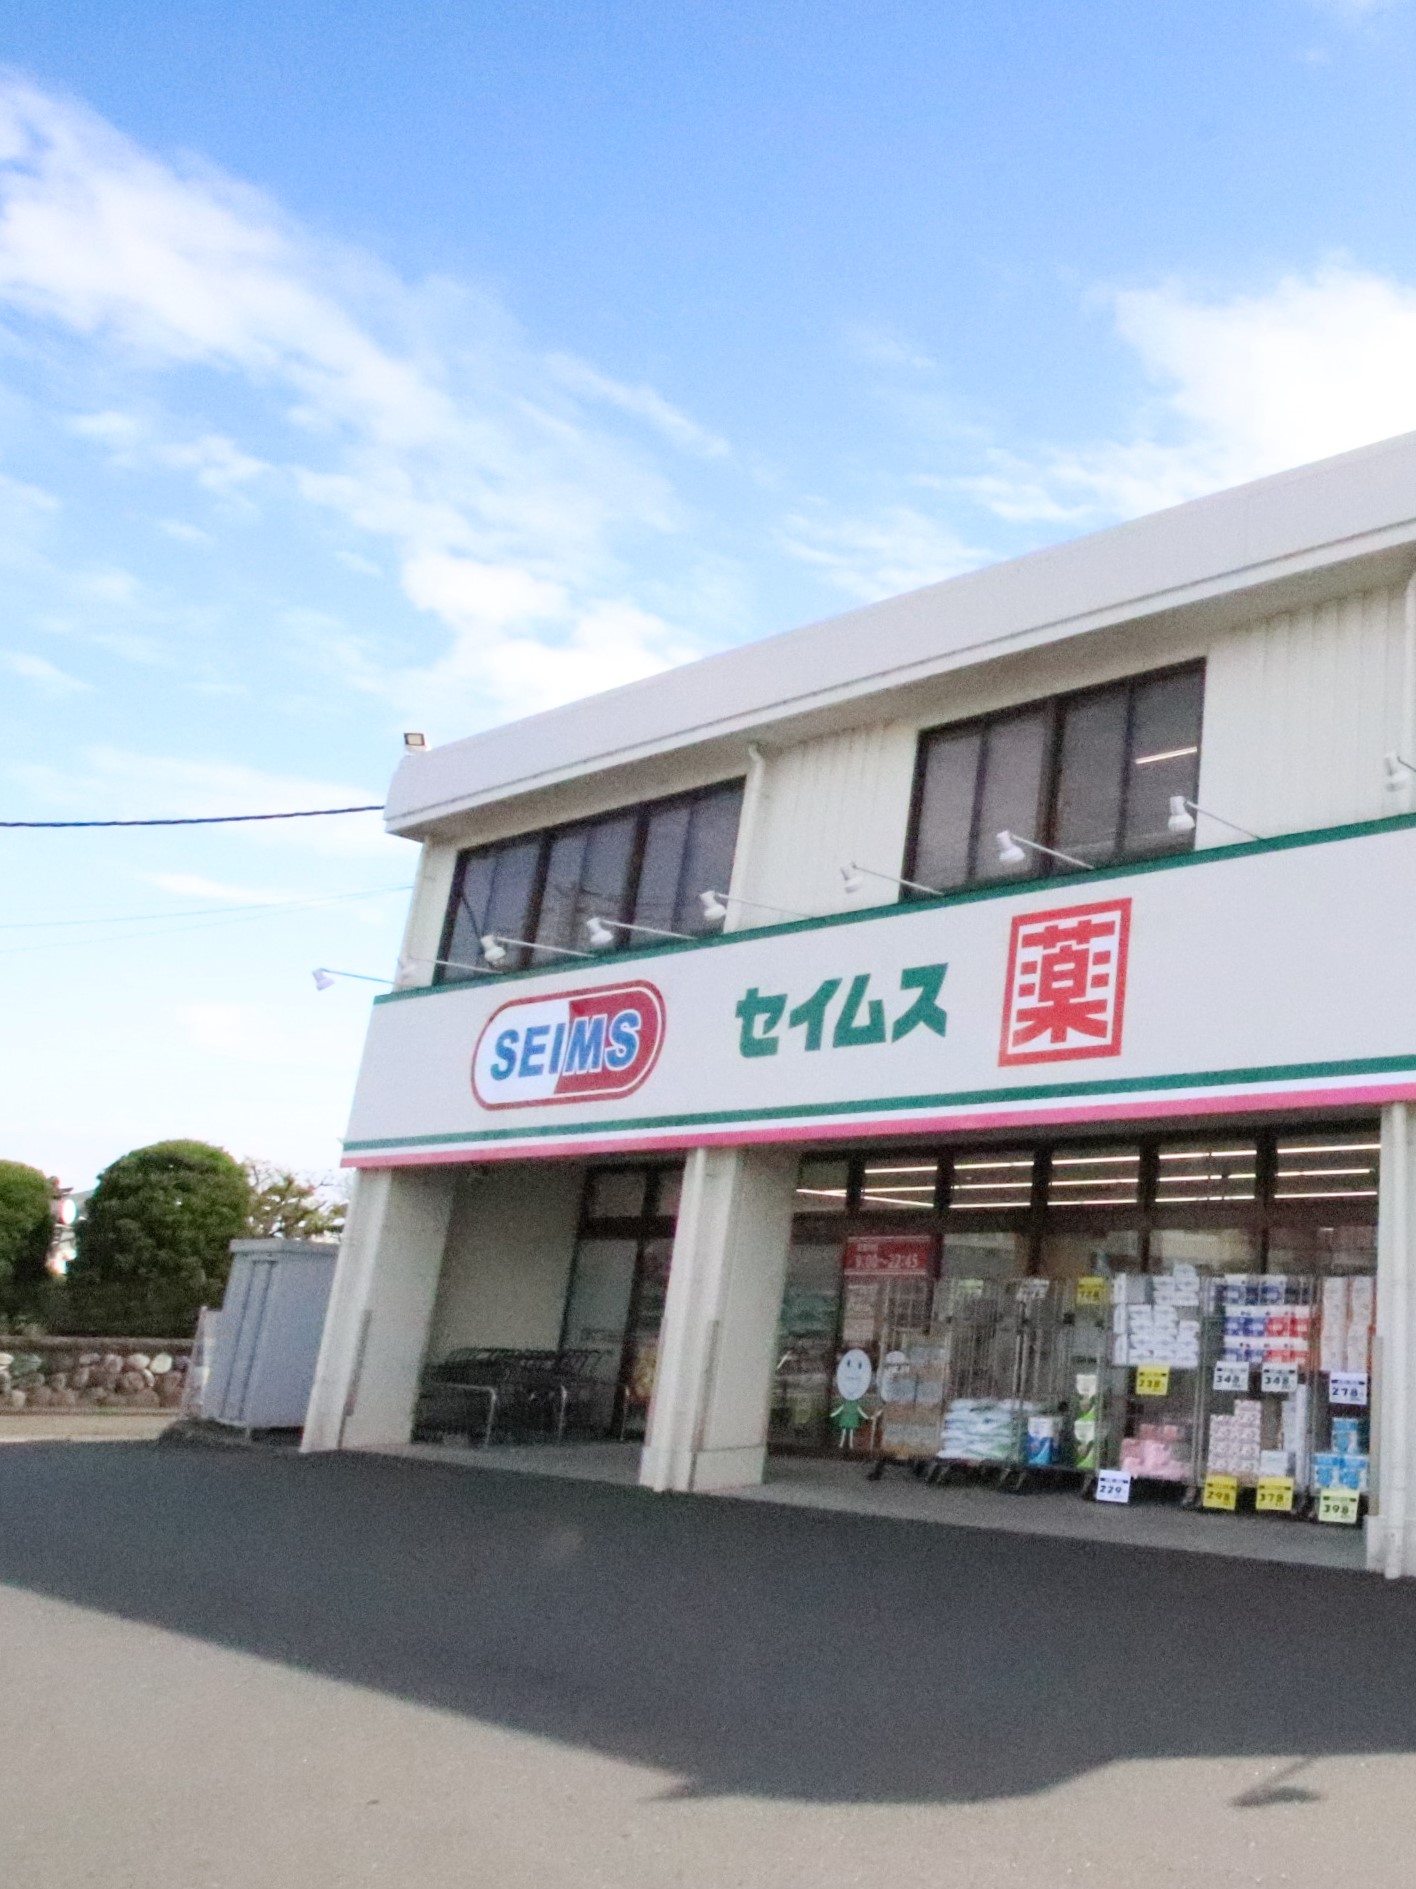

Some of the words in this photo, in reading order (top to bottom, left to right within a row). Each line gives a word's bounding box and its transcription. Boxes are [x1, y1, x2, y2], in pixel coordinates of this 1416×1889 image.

[735, 962, 949, 1059] セイムス
[1011, 916, 1110, 1047] 薬
[489, 1007, 642, 1082] SEIMS
[1331, 1387, 1358, 1397] 278
[1323, 1504, 1349, 1515] 398
